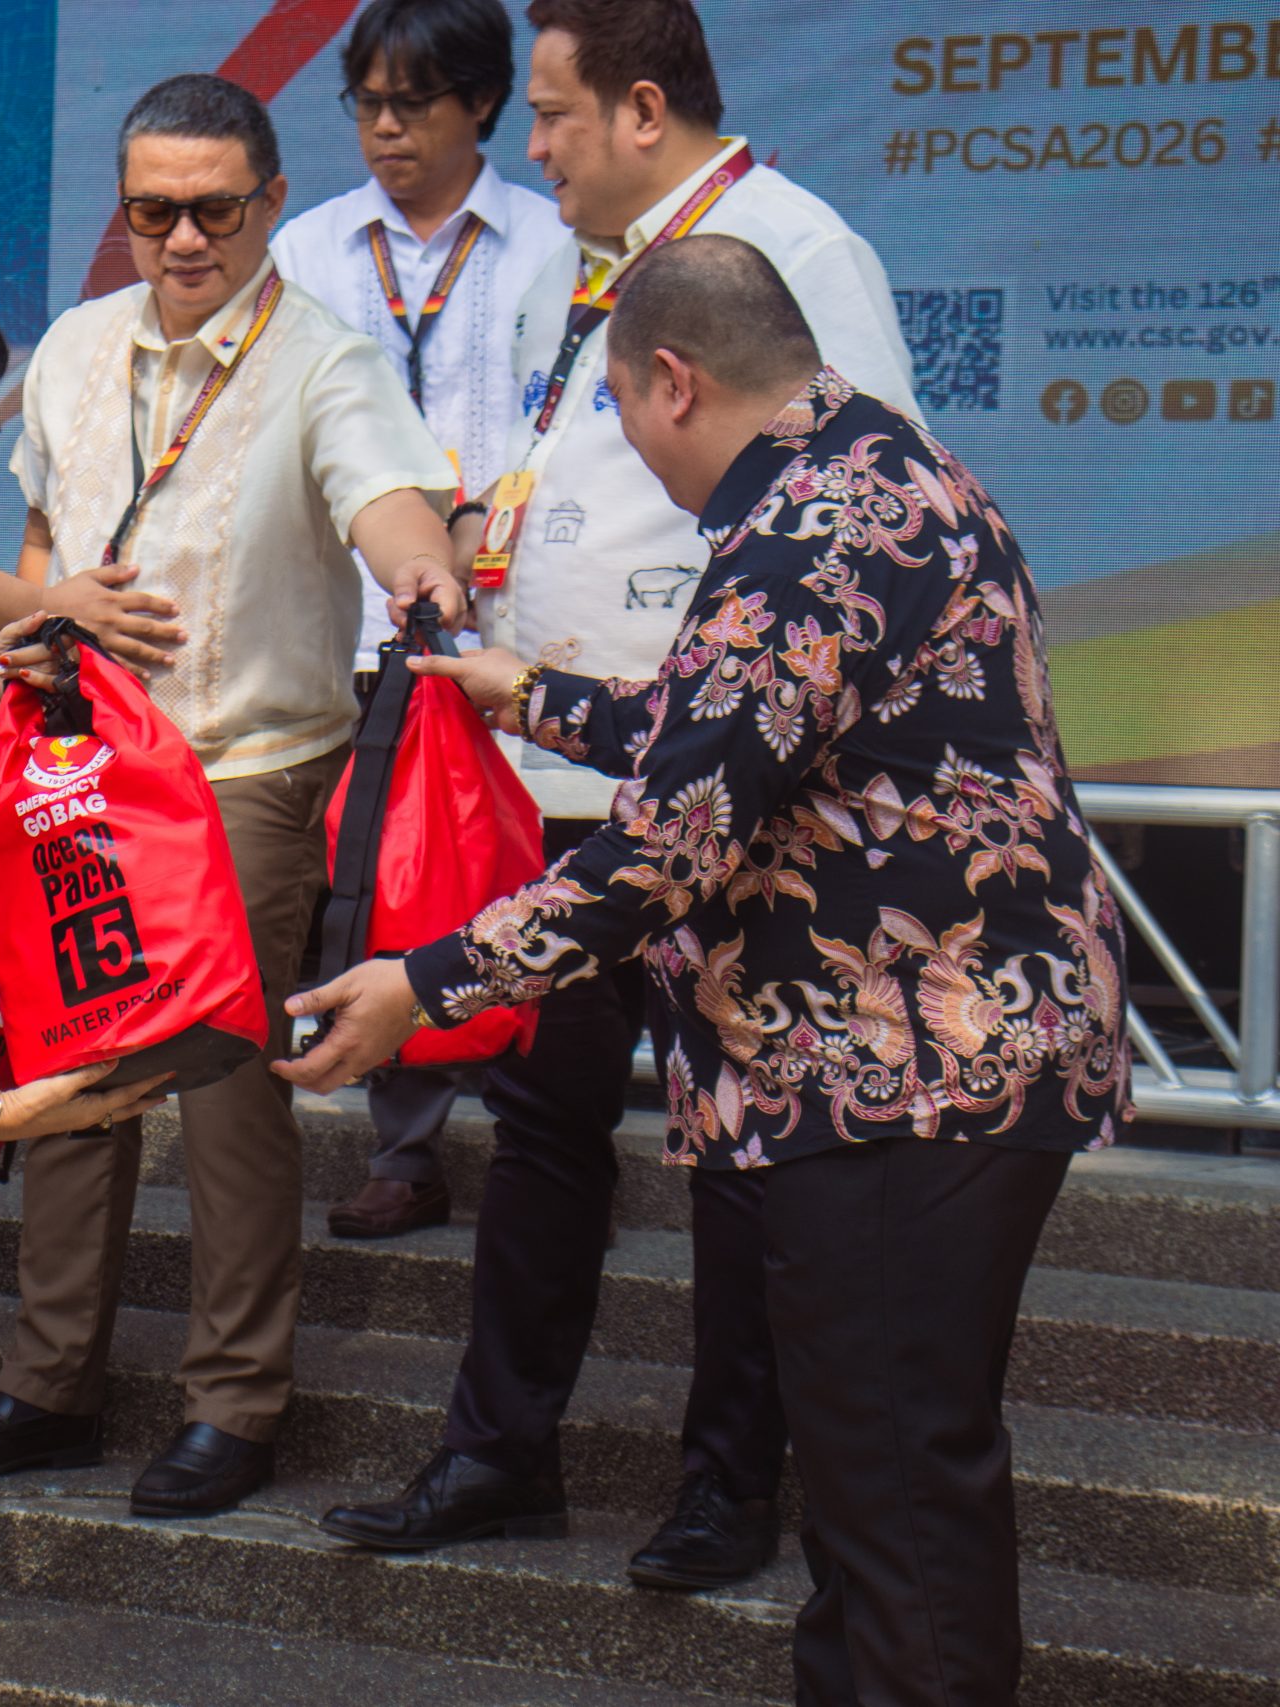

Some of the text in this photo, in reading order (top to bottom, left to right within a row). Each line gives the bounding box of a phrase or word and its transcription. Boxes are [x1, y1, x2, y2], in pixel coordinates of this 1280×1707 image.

[885, 118, 1226, 175] #PCSA2026
[1045, 283, 1121, 311] Visit
[1130, 281, 1188, 311] the
[15, 776, 100, 816] EMERGENCY
[23, 793, 107, 837] GO BAG
[59, 908, 133, 991] 15
[41, 1007, 112, 1047] WATER
